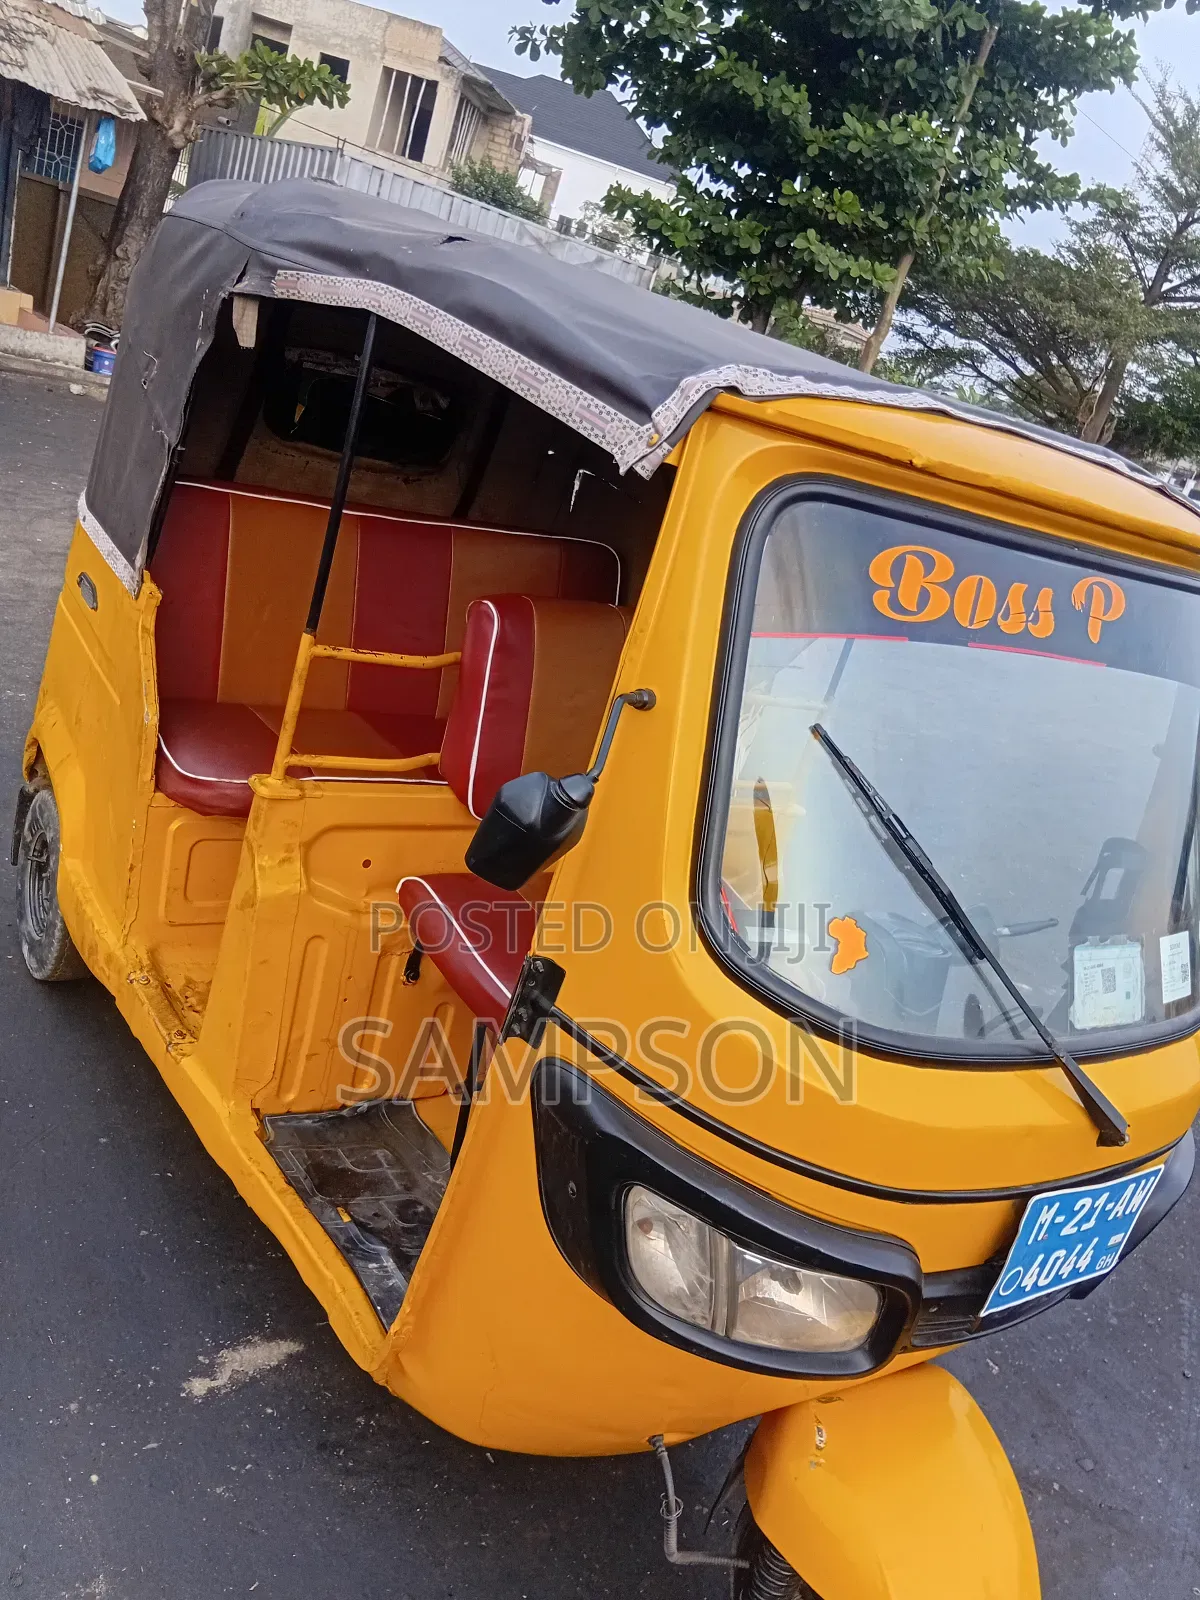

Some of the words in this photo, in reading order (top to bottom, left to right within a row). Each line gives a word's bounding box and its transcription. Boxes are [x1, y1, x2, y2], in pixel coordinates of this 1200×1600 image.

[1071, 576, 1126, 644] P
[1020, 1237, 1099, 1292] 4044
[1095, 1252, 1116, 1271] GH
